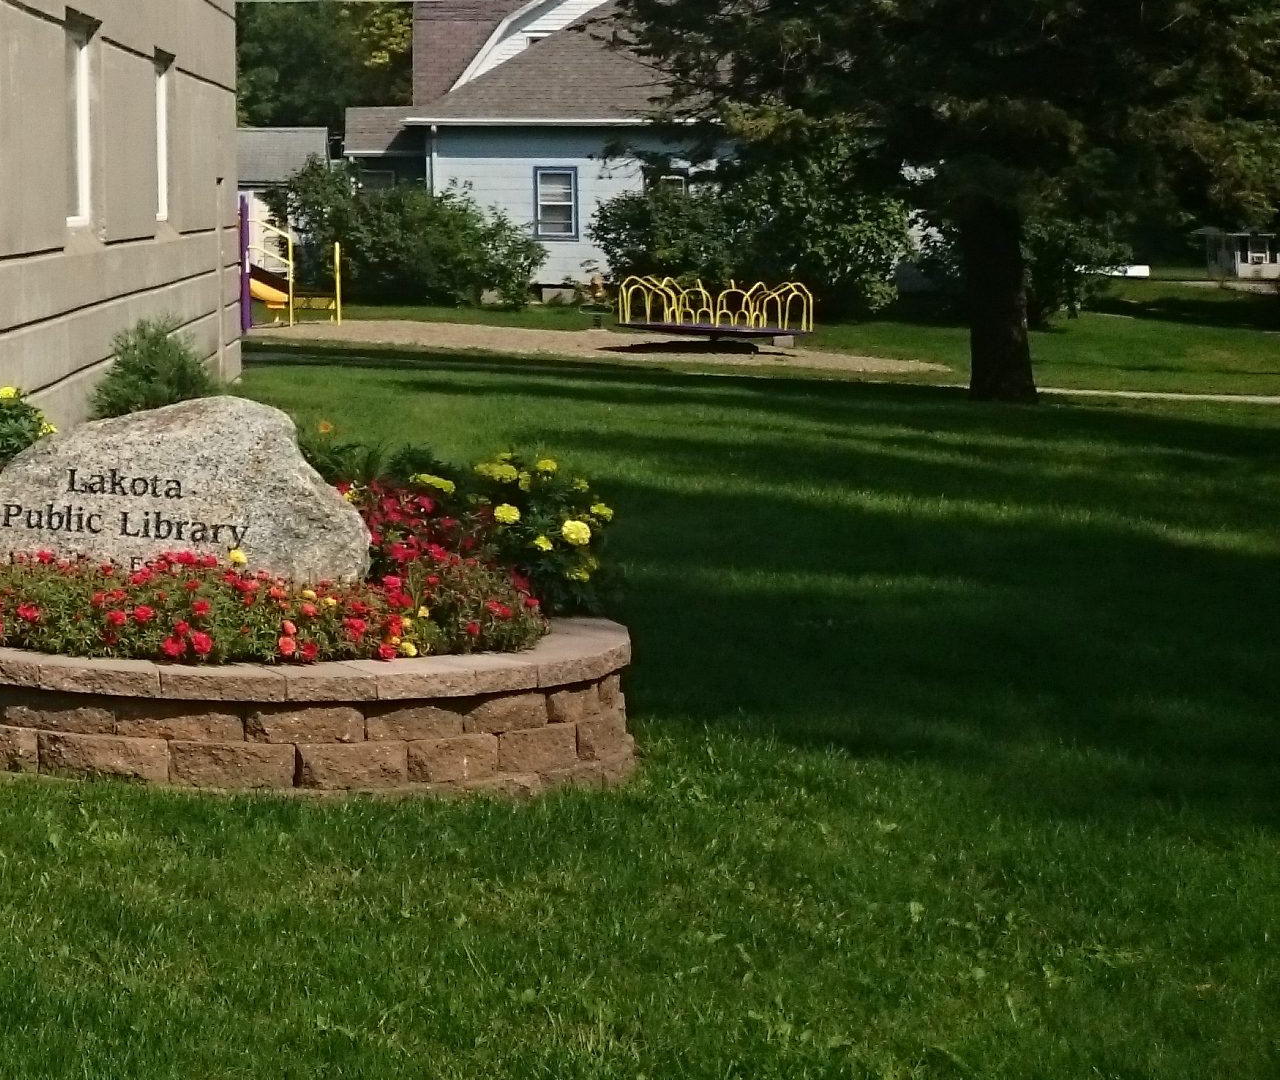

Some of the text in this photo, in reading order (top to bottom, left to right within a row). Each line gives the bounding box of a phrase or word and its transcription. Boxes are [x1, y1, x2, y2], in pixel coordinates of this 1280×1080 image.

[66, 468, 183, 499] Lakota
[2, 503, 250, 552] Public Library
